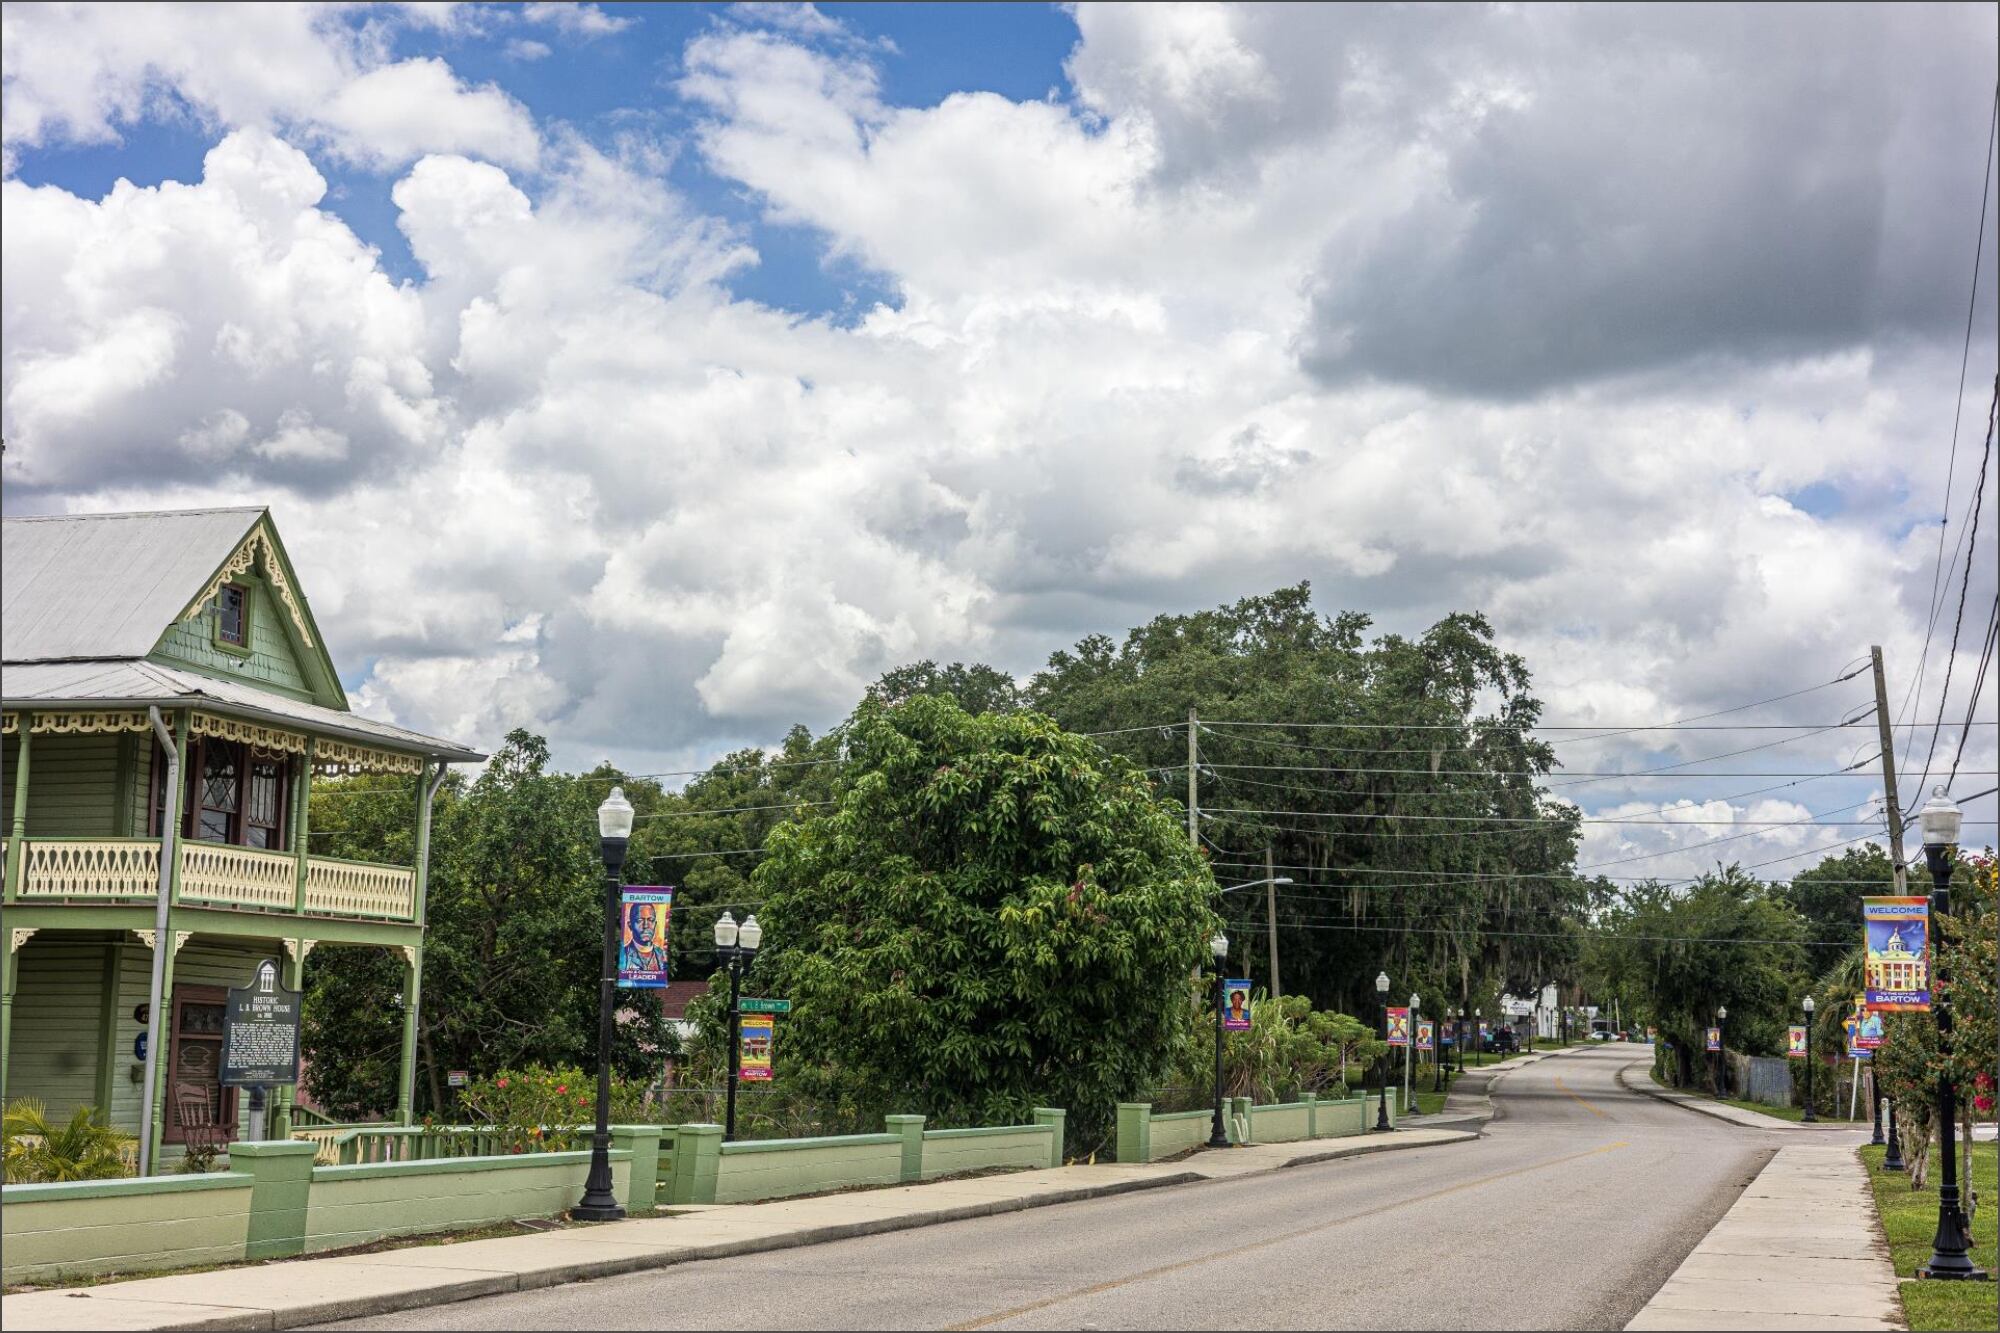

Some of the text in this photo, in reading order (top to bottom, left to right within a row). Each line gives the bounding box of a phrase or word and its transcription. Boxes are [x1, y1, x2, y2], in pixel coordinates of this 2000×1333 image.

[253, 996, 279, 1004] HISTORIC
[1875, 995, 1921, 1003] BARTOW
[252, 1004, 271, 1012] BROWN
[273, 1004, 291, 1013] HOUSE
